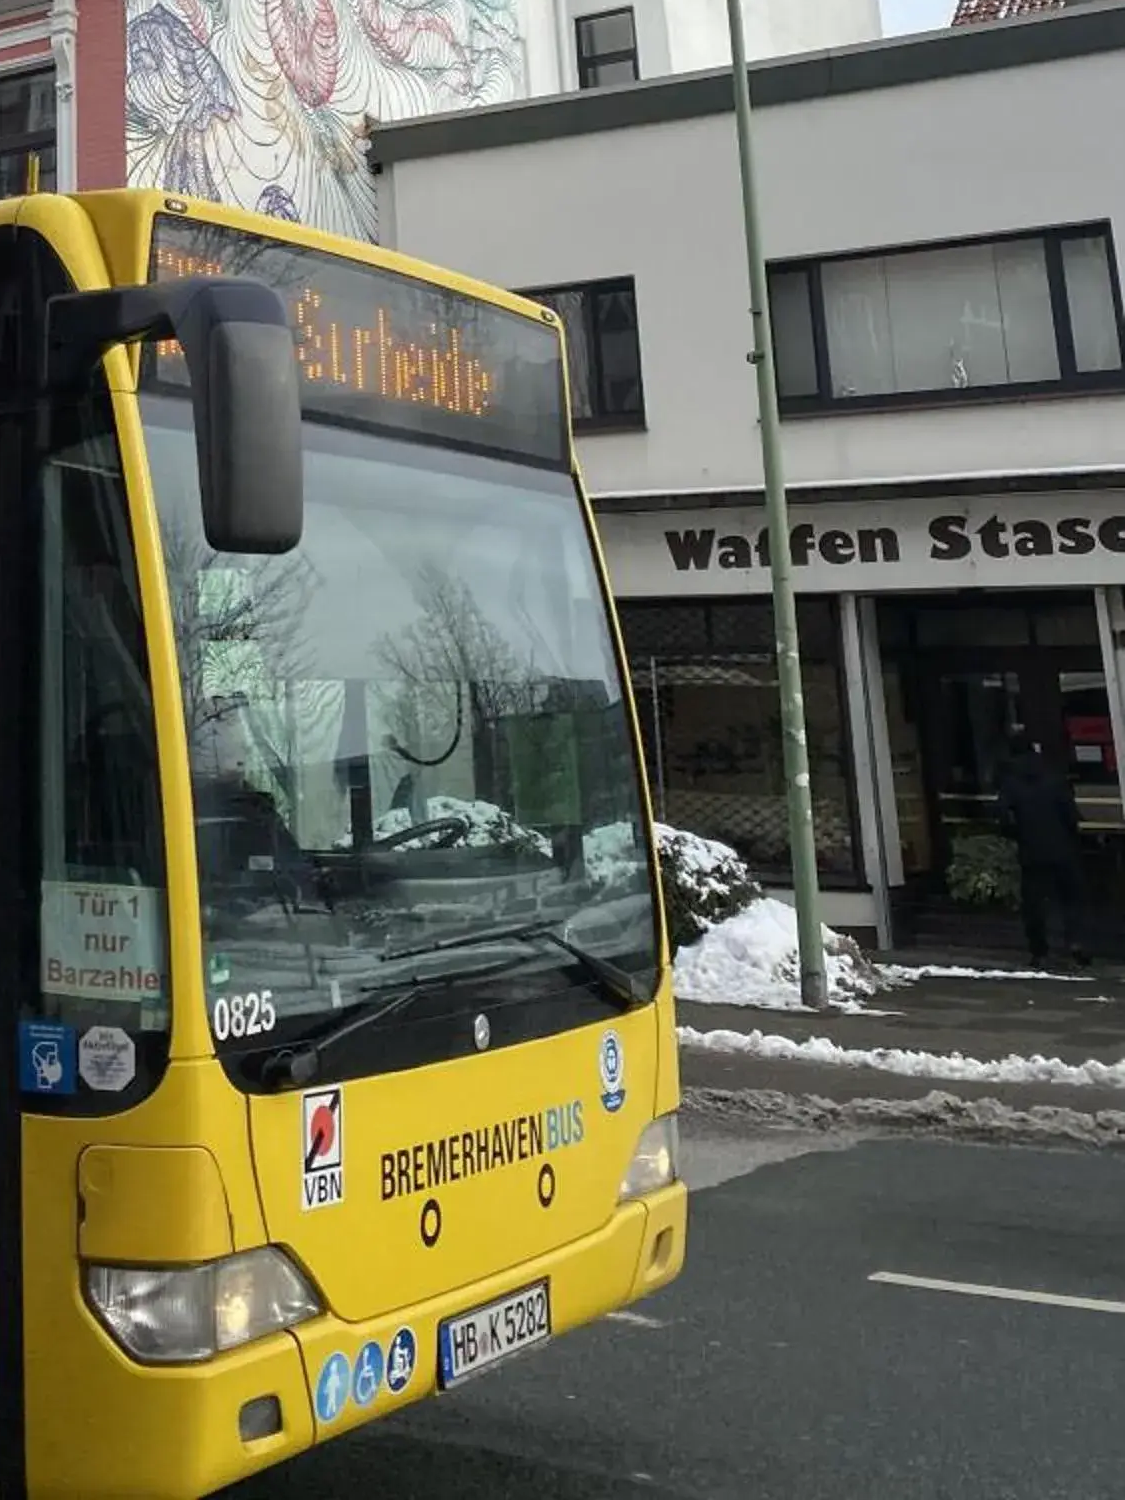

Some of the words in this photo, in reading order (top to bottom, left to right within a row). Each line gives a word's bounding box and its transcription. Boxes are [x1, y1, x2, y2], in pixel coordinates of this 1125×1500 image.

[665, 523, 900, 571] Waffen
[75, 891, 119, 917] Tür
[128, 895, 139, 919] 1
[84, 932, 131, 953] nur
[214, 989, 275, 1041] 0825
[381, 1112, 543, 1201] BREMERHAVEN
[547, 1099, 584, 1150] BUS
[304, 1172, 342, 1206] VBN
[452, 1321, 478, 1370] HB
[489, 1311, 502, 1353] K
[504, 1291, 546, 1345] 5282
